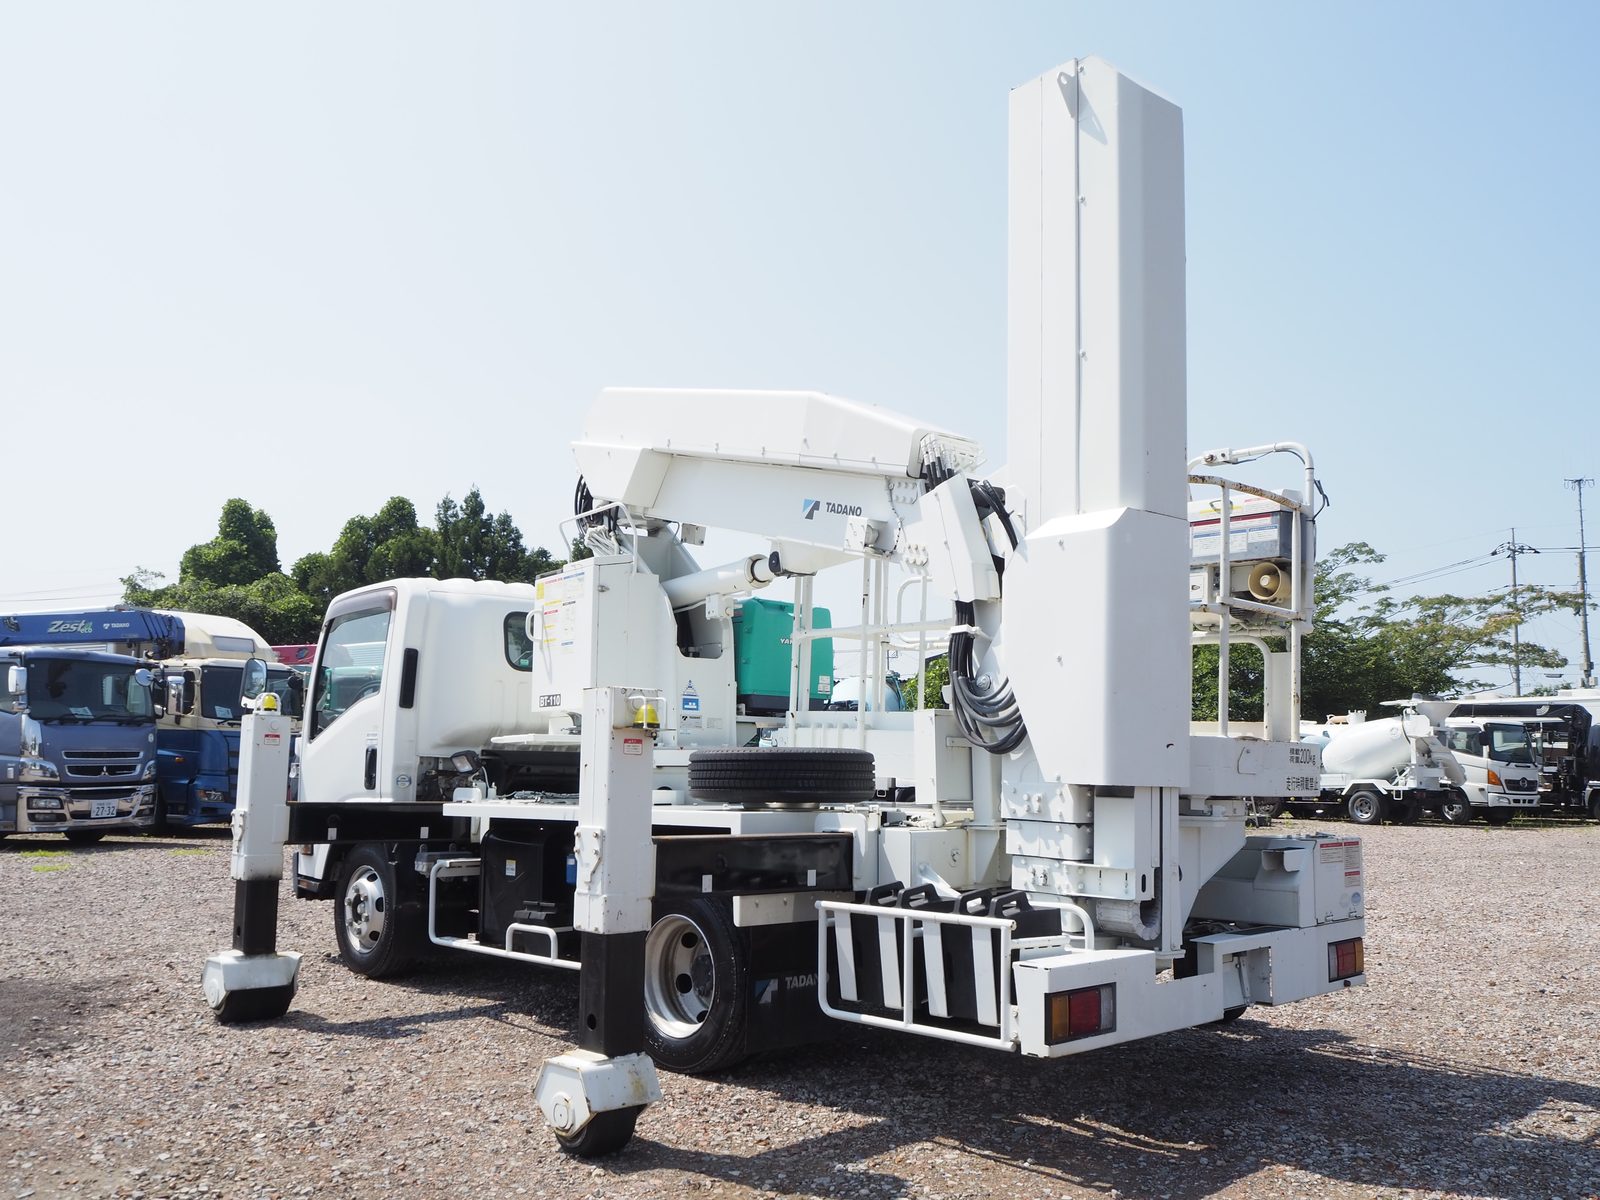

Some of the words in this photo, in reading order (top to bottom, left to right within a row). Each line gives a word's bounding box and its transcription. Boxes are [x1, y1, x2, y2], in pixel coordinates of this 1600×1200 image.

[826, 502, 862, 517] TADANO
[48, 620, 86, 633] Zest
[540, 695, 561, 707] BT-110
